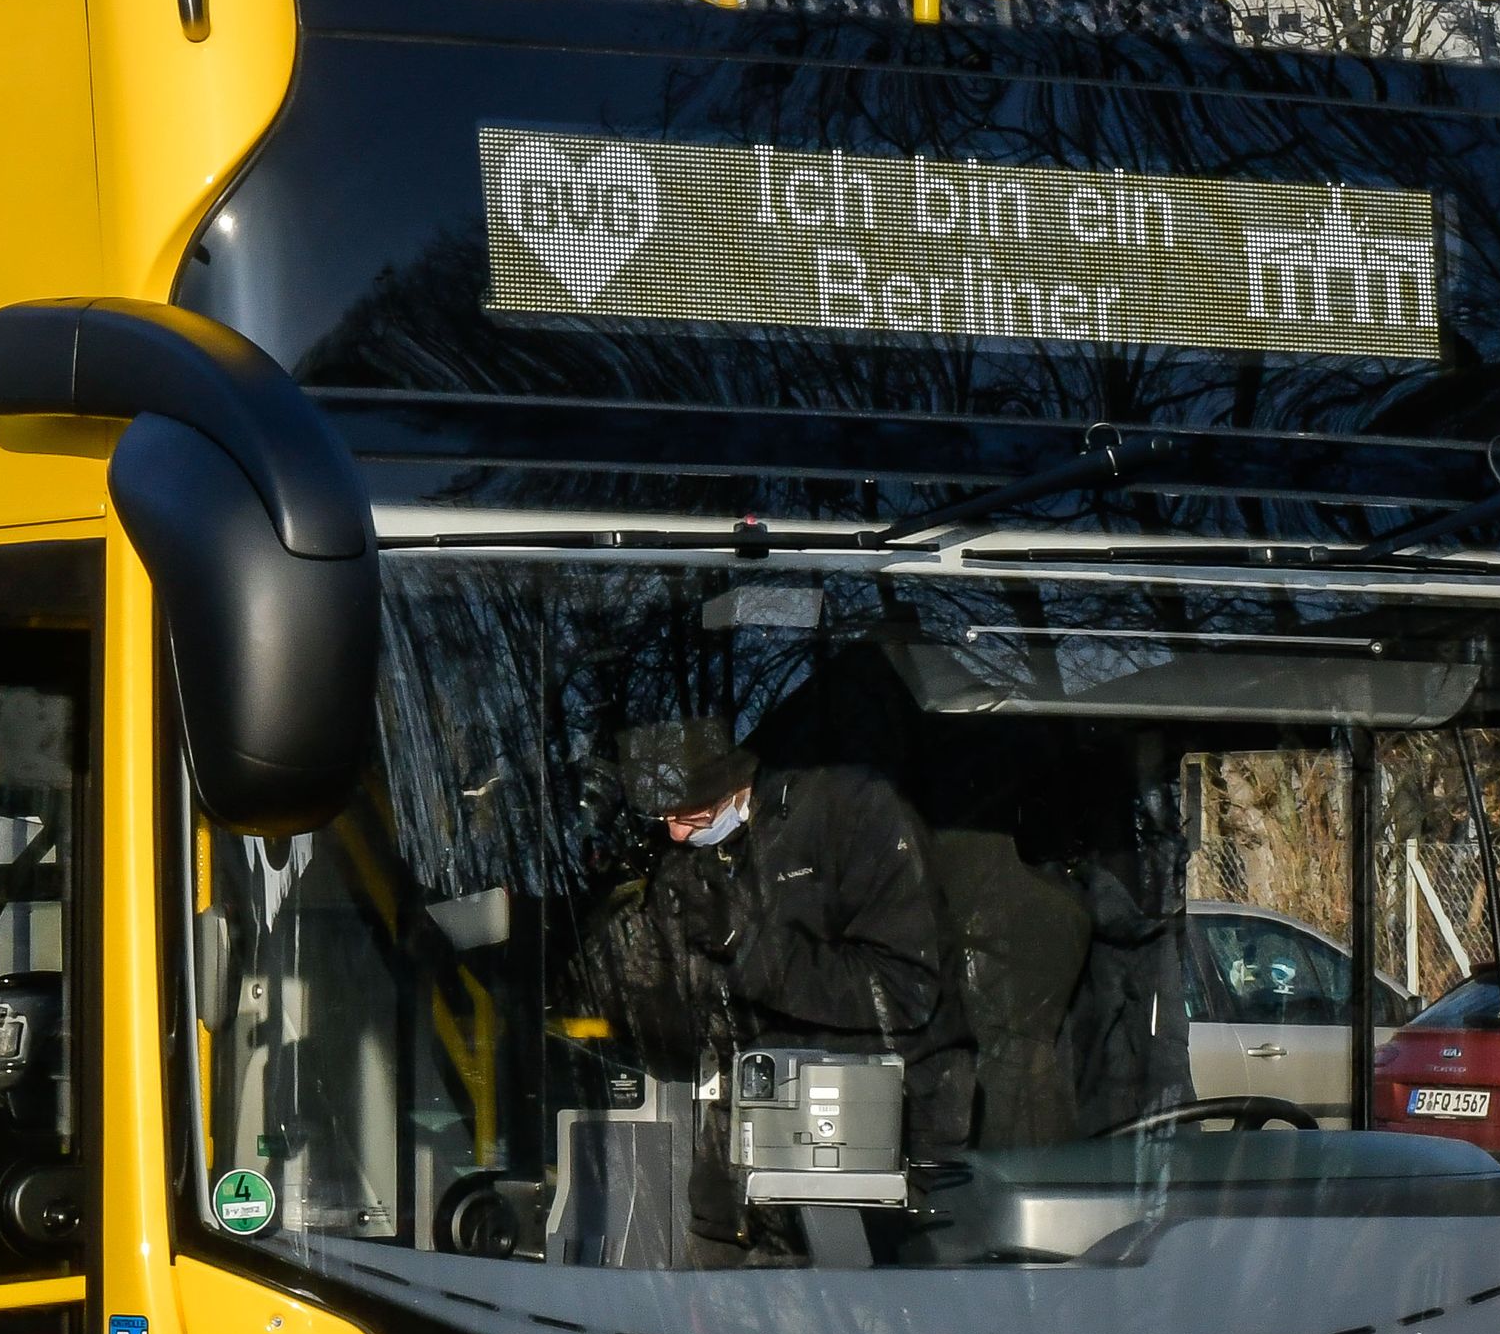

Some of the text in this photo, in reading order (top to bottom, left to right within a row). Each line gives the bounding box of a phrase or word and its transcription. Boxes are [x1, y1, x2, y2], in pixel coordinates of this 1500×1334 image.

[520, 179, 646, 239] BVG
[753, 144, 1175, 248] Ich bin ein
[817, 245, 1122, 343] Berliner
[1417, 1093, 1488, 1113] B FQ 1567
[235, 1175, 251, 1202] 4
